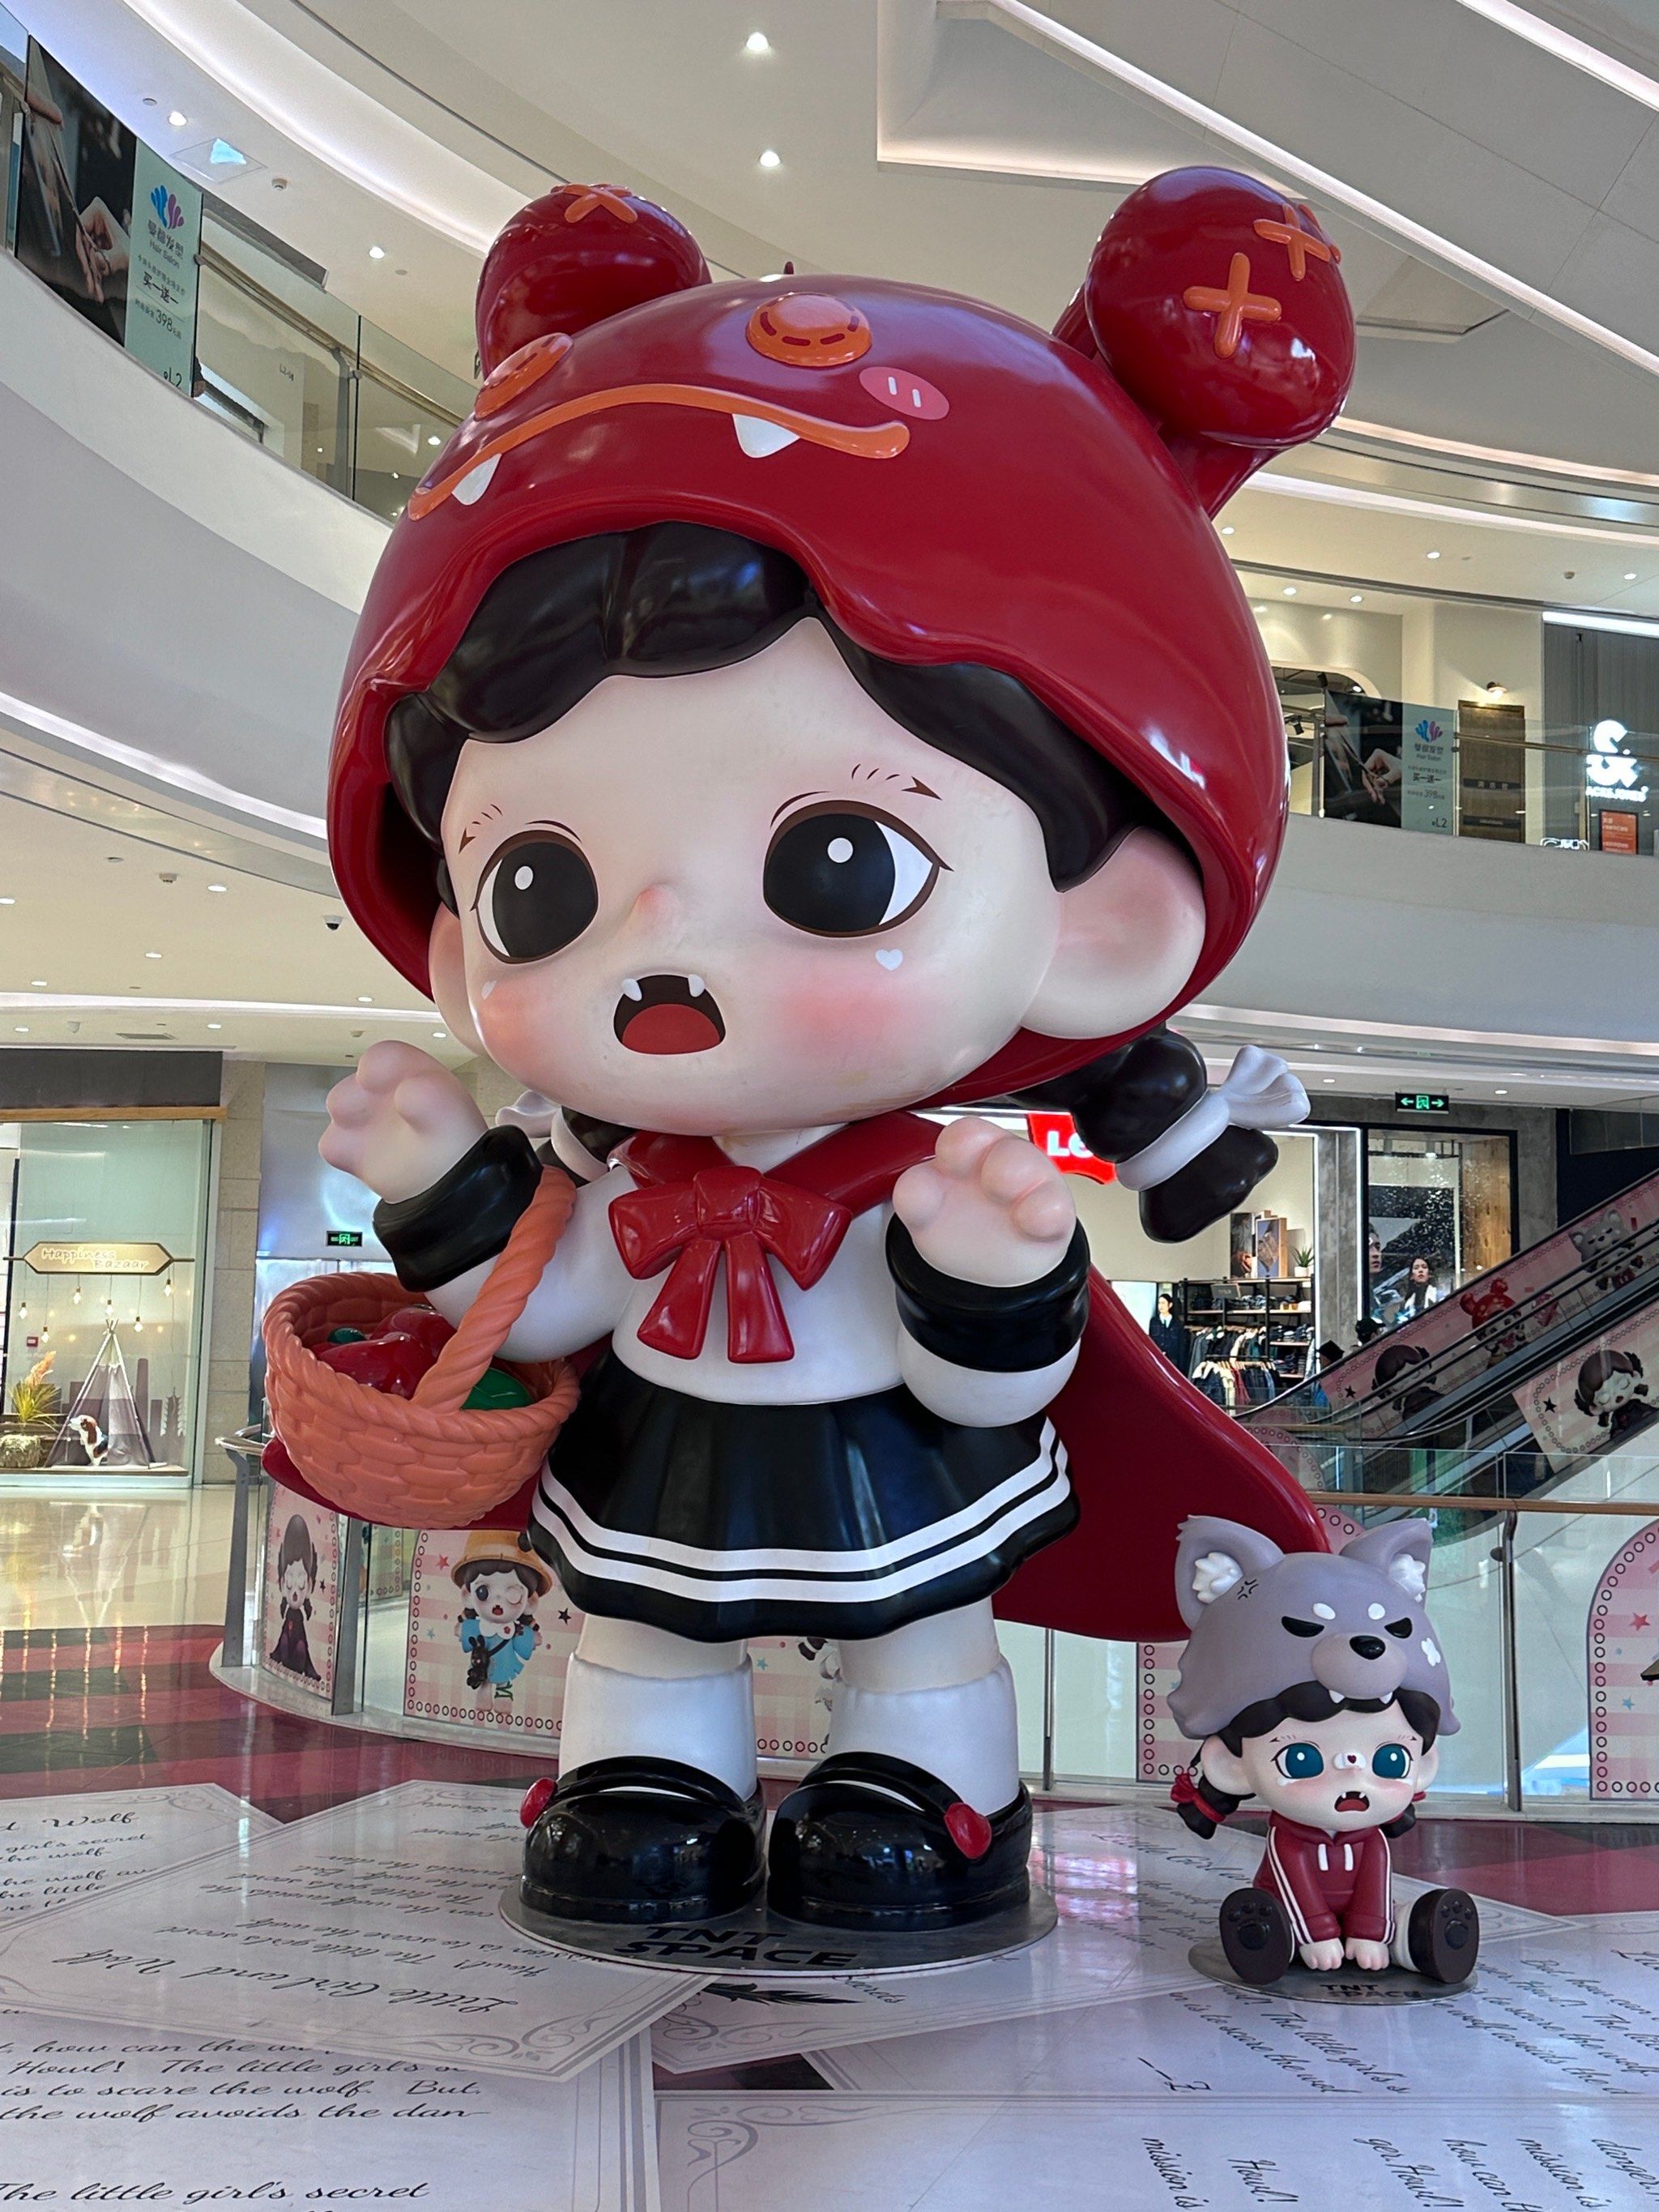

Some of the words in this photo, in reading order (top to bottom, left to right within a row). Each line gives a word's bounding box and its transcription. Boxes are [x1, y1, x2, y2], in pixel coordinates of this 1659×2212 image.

[143, 271, 178, 303] 买一送一
[1413, 772, 1442, 784] 买一送一
[42, 1246, 116, 1263] Happiness
[93, 1258, 149, 1270] Bazaar
[41, 1812, 139, 1828] Wolf
[78, 1833, 151, 1846] secret
[1166, 1855, 1243, 1871] Girl
[43, 1882, 106, 1895] little
[198, 1884, 242, 1894] the
[437, 1894, 484, 1904] The
[395, 1904, 440, 1914] the
[448, 1908, 494, 1917] can
[153, 1926, 239, 1938] secret
[313, 1927, 360, 1937] the
[363, 1932, 437, 1944] scare
[645, 1927, 787, 1945] TNT
[312, 1944, 380, 1958] little
[442, 1941, 471, 1949] to
[479, 1944, 503, 1953] is
[52, 1949, 176, 1974] Wolf
[385, 1951, 436, 1965] The
[614, 1941, 857, 1967] SPACE
[180, 1966, 289, 1981] and
[454, 1959, 550, 1977] Howl!
[271, 1977, 380, 1997] Girl
[388, 1989, 518, 2013] Little
[1565, 1979, 1614, 1996] how
[1610, 1999, 1652, 2014] can
[1504, 2007, 1565, 2031] scare
[1559, 2033, 1606, 2049] the
[1581, 2013, 1631, 2031] The
[1183, 2003, 1212, 2012] is
[1201, 2014, 1232, 2024] to
[1219, 2026, 1274, 2052] scare
[1264, 2054, 1311, 2072] the
[1260, 2011, 1308, 2030] The
[1294, 2031, 1358, 2056] little
[32, 2040, 108, 2053] how
[121, 2043, 185, 2053] can
[197, 2039, 256, 2053] the
[1447, 2009, 1518, 2031] wolf
[1561, 2068, 1612, 2085] the
[7, 2060, 126, 2076] Howl!
[160, 2059, 224, 2074] The
[236, 2059, 323, 2073] little
[0, 2085, 32, 2097] is
[46, 2083, 86, 2096] to
[96, 2085, 198, 2097] scare
[209, 2080, 272, 2096] the
[0, 2104, 64, 2120] the
[75, 2103, 175, 2124] wolf
[174, 2103, 306, 2120] avoids
[318, 2103, 383, 2119] the
[1141, 2137, 1194, 2192] mission
[1174, 2195, 1210, 2210] is
[1442, 2137, 1488, 2168] how
[1473, 2171, 1512, 2197] can
[1516, 2137, 1585, 2192] mission
[1576, 2195, 1612, 2208] is
[1226, 2159, 1299, 2202] Howl!
[1384, 2163, 1465, 2207] Howl!
[0, 2182, 58, 2201] The
[70, 2182, 176, 2201] little
[182, 2180, 292, 2206] girl's
[305, 2182, 433, 2200] secret
